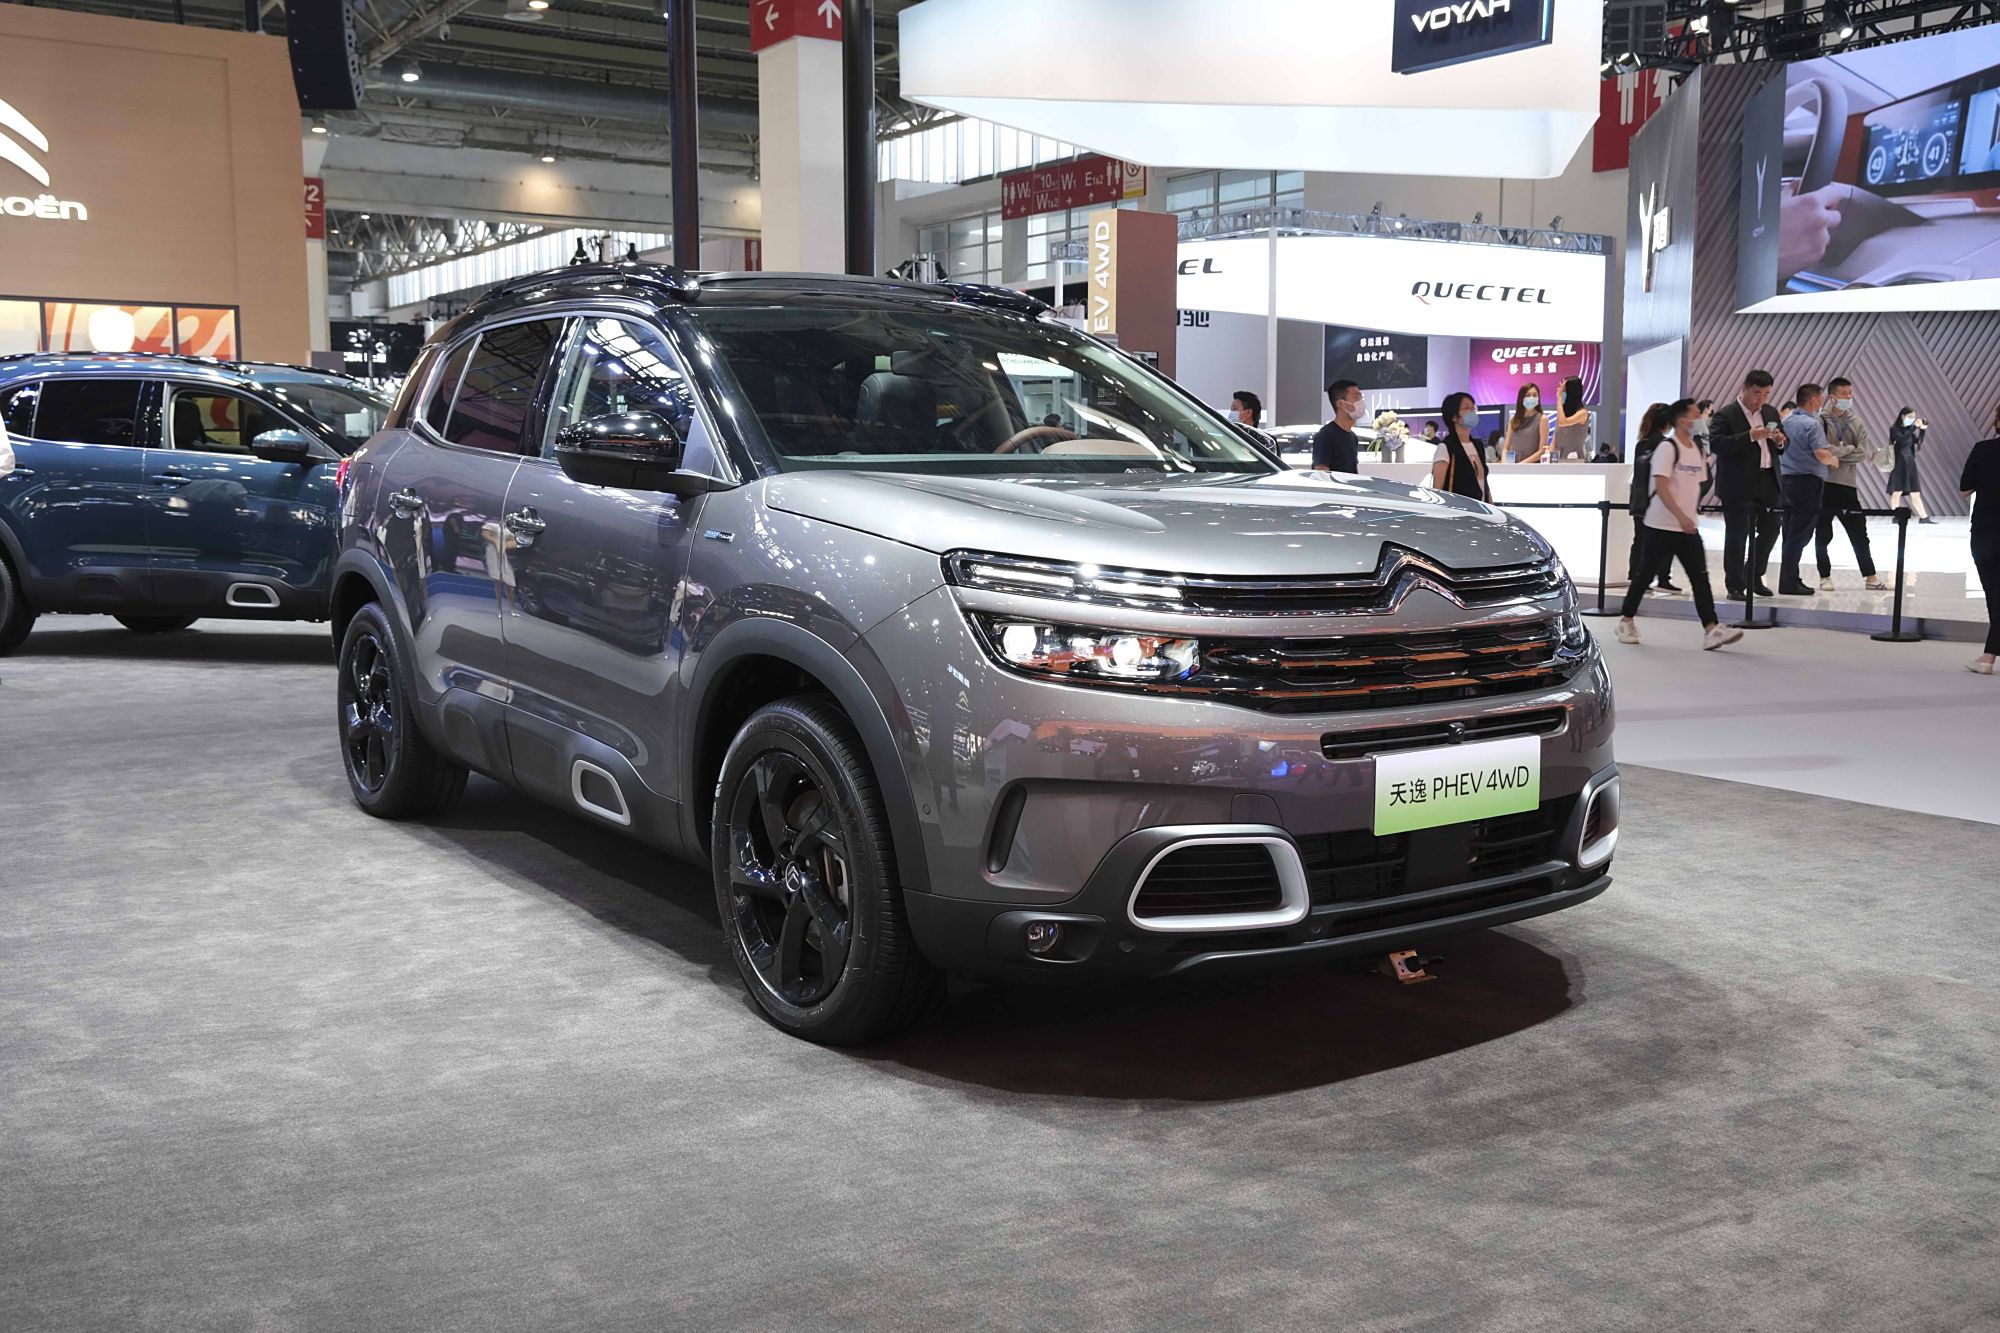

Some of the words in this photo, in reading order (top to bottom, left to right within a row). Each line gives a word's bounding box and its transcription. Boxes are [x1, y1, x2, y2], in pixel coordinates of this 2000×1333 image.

[1411, 0, 1511, 33] VOYAH
[1094, 221, 1110, 289] 4WD
[1411, 281, 1551, 305] QUECTEL
[1491, 344, 1577, 363] QUECTEL
[1389, 778, 1427, 807] 天逸
[1433, 771, 1483, 800] PHEV
[1486, 766, 1530, 791] 4WD
